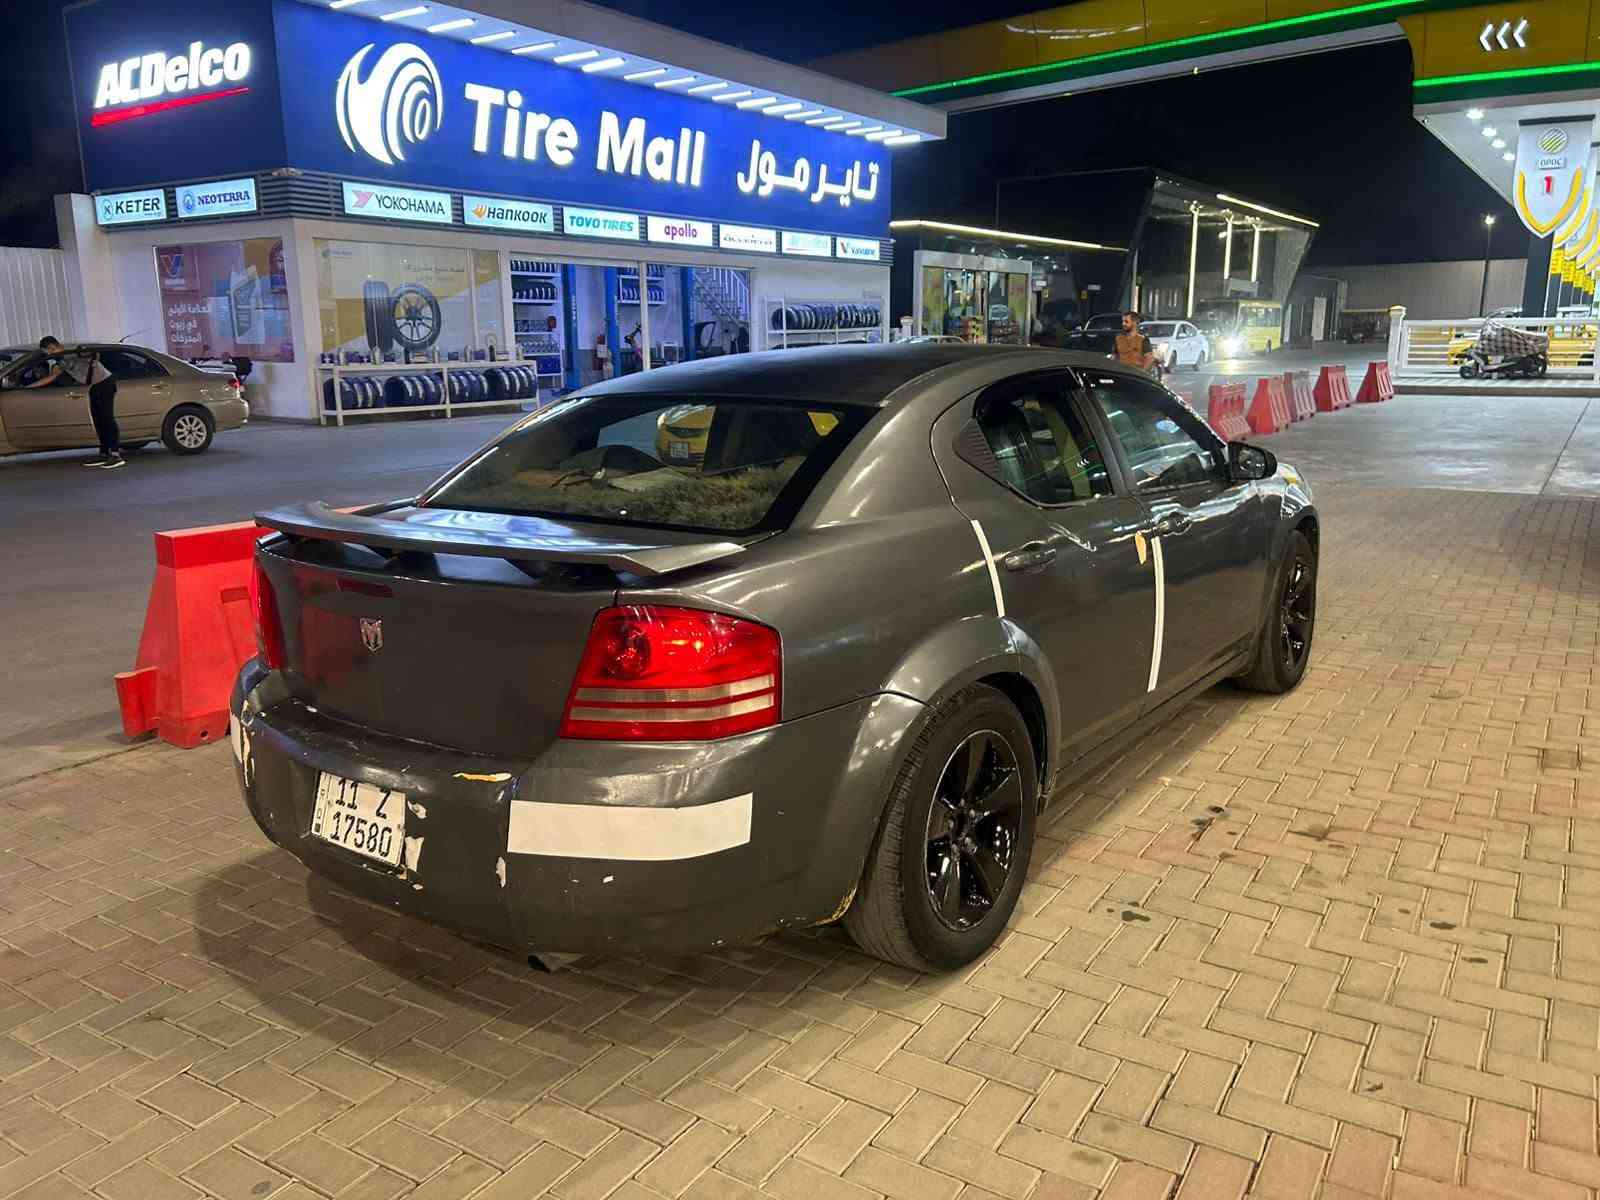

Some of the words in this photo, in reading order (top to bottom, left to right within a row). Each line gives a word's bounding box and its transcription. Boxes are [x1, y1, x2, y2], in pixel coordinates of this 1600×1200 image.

[94, 41, 250, 109] ACDelco
[464, 82, 579, 166] Tire
[596, 110, 705, 187] Mall
[736, 139, 810, 196] مول
[810, 160, 880, 207] تاير
[1544, 175, 1553, 193] 1
[115, 197, 161, 215] KETER
[197, 190, 251, 206] NEOTERRA
[375, 193, 446, 216] YOKOHAMA
[602, 218, 635, 232] TIRES
[663, 222, 698, 241] apollo
[335, 778, 358, 810] 11
[330, 811, 392, 858] 17580
